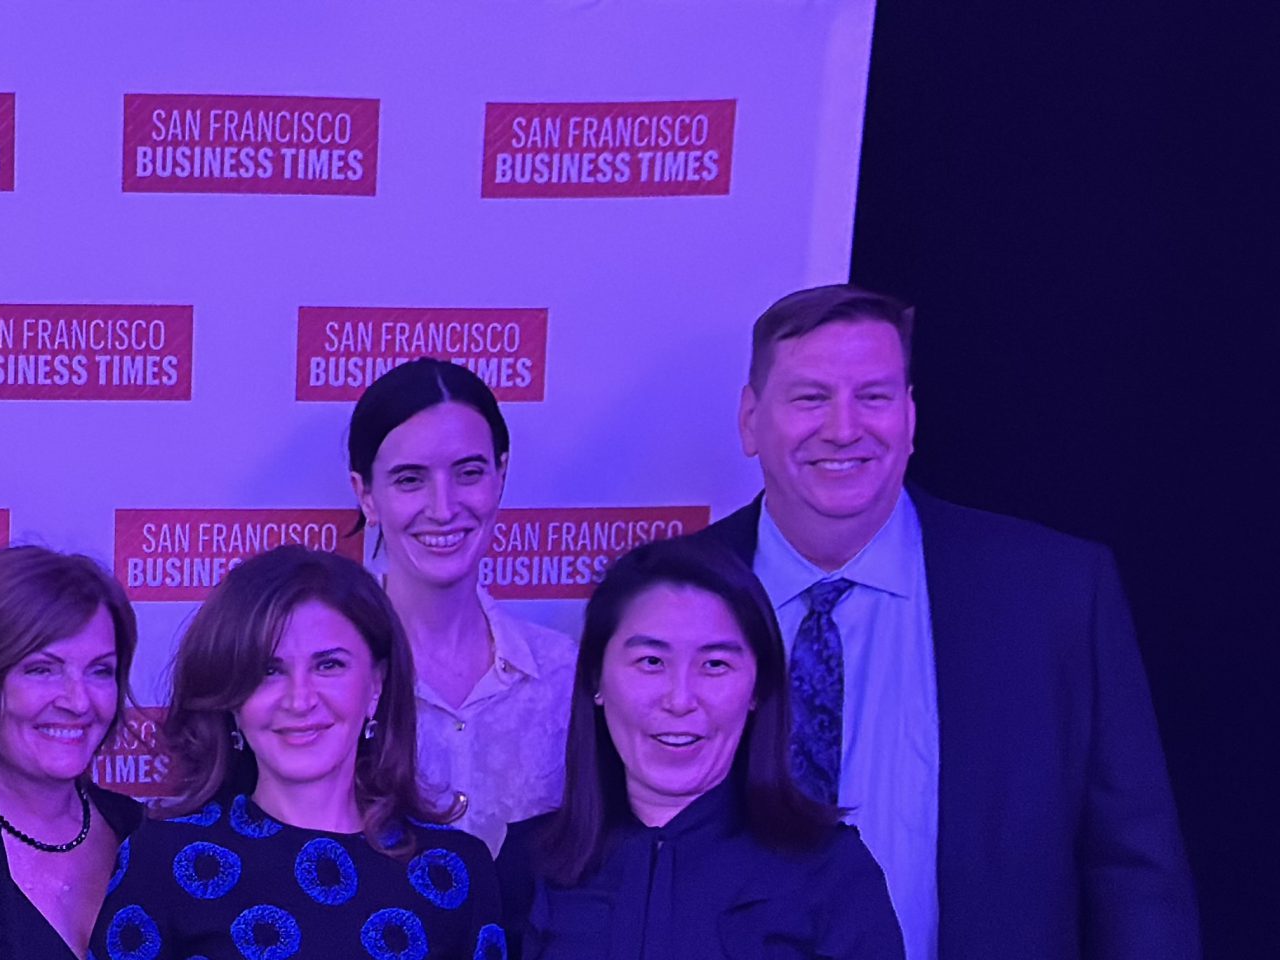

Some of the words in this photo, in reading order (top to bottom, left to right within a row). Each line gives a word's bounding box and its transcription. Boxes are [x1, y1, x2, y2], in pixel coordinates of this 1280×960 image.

[152, 109, 201, 141] SAN
[210, 110, 351, 145] FRANCISCO
[511, 115, 562, 149] SAN
[568, 114, 708, 148] FRANCISCO
[136, 146, 273, 178] BUSINESS
[281, 149, 363, 181] TIMES
[495, 152, 630, 184] BUSINESS
[638, 149, 719, 182] TIMES
[23, 319, 165, 350] FRANCISCO
[325, 321, 373, 352] SAN
[381, 321, 520, 353] FRANCISCO
[95, 355, 178, 386] TIMES
[143, 523, 190, 553] SAN
[199, 523, 337, 553] FRANCISCO
[492, 522, 541, 552] SAN
